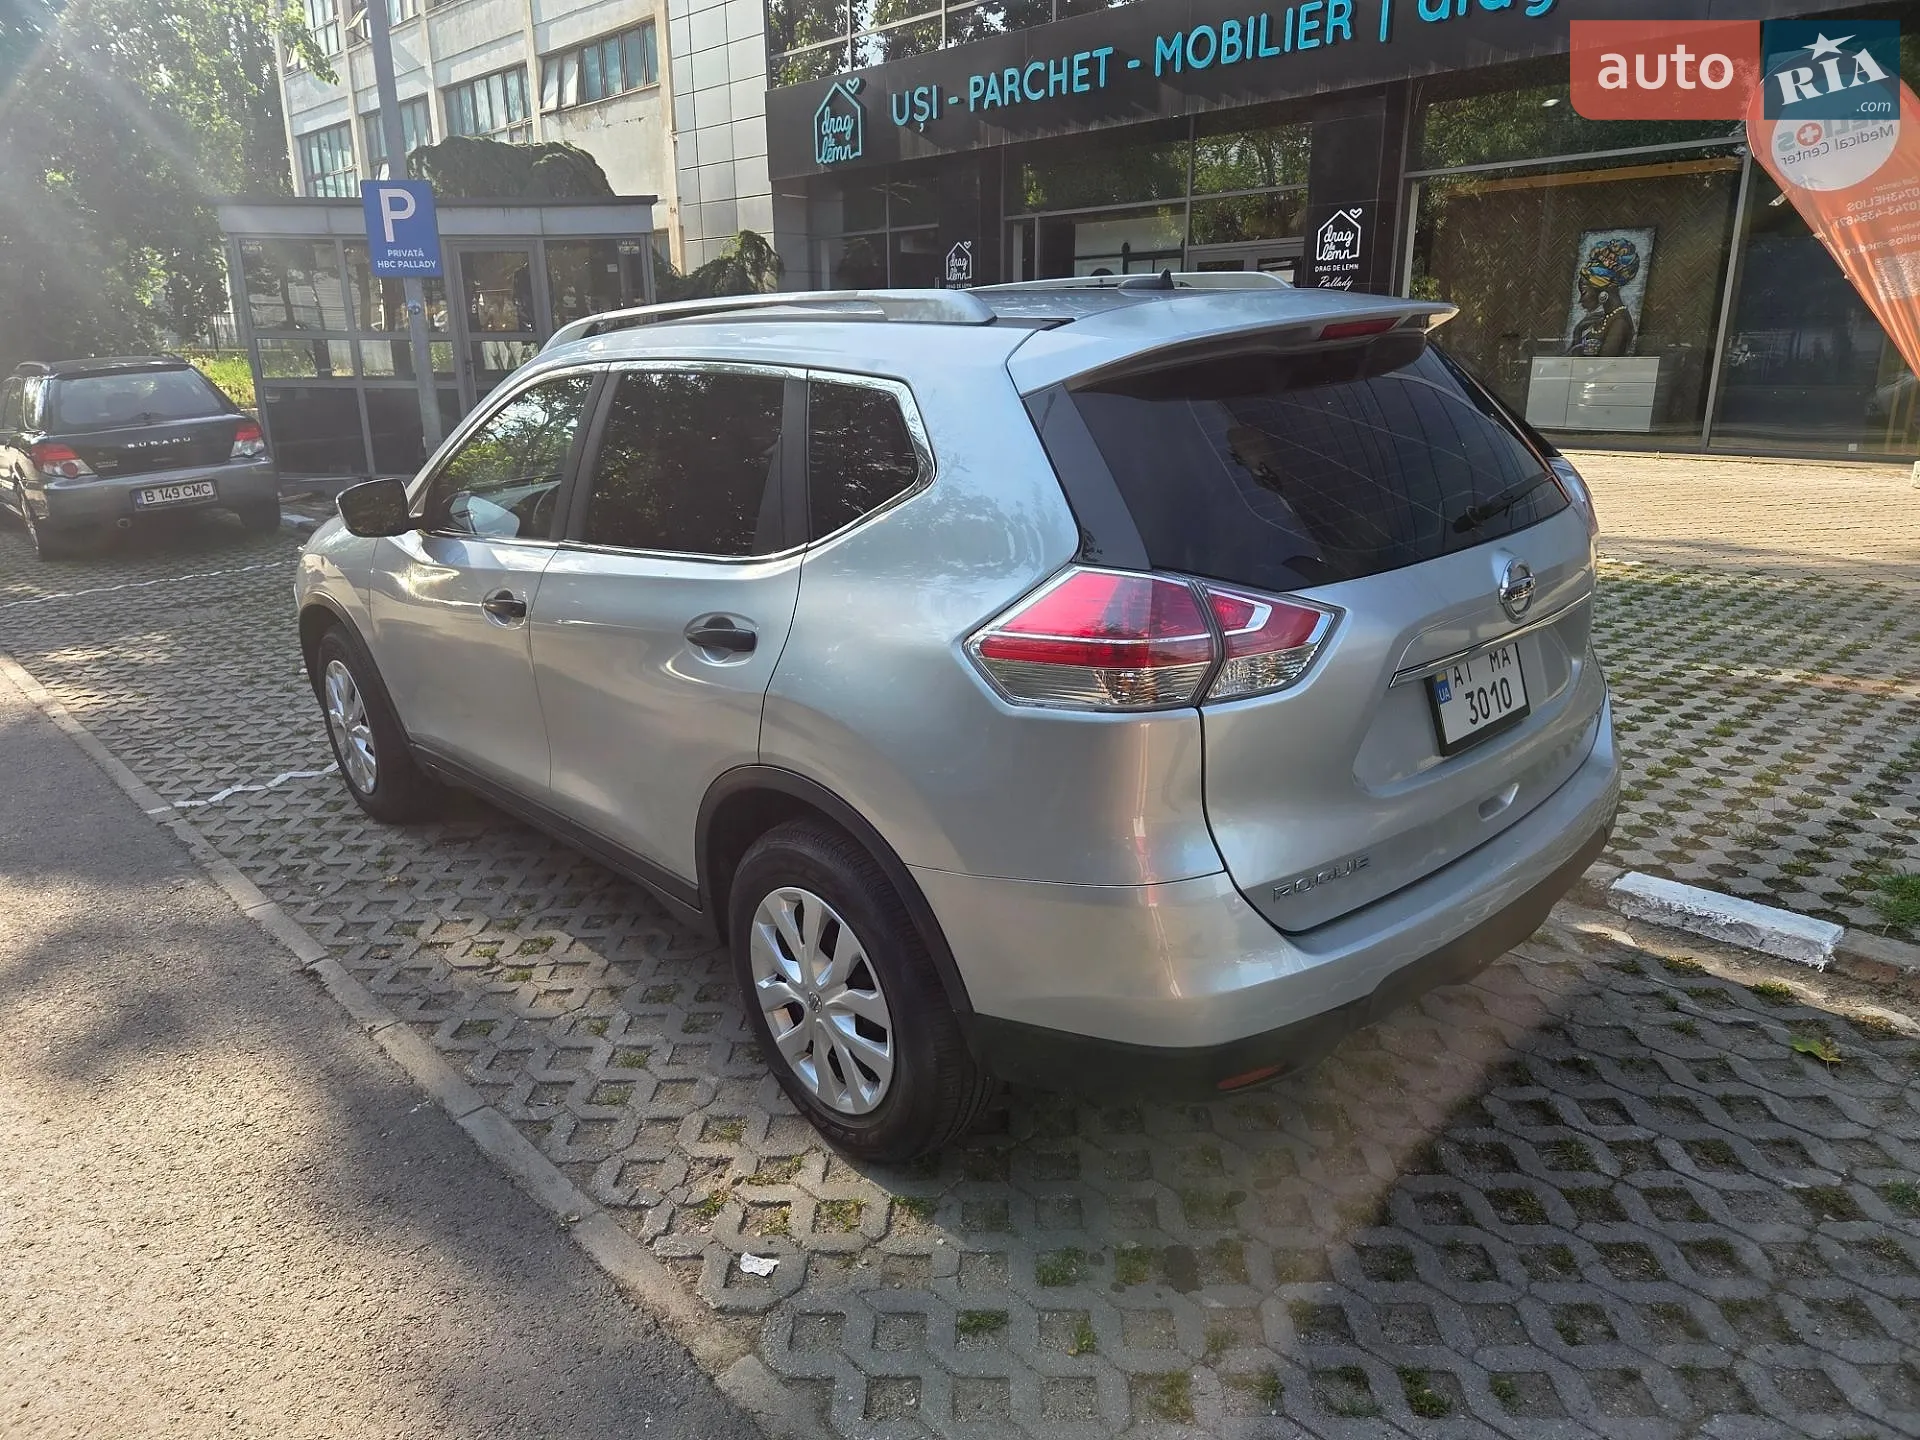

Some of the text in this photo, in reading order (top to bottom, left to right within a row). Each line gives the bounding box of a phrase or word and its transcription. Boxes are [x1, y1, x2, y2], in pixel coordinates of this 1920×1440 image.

[892, 84, 938, 133] UȘI
[968, 46, 1114, 112] PARCHET
[1154, 0, 1352, 77] MOBILIER
[821, 106, 854, 141] drag
[820, 136, 854, 163] lemn
[379, 188, 416, 242] P
[1323, 224, 1355, 247] drag
[1321, 243, 1351, 260] lemn
[377, 260, 437, 269] HBC PALLADY
[1342, 263, 1359, 271] LEMN
[145, 491, 155, 502] B
[159, 487, 180, 501] 149
[183, 483, 211, 497] CMC
[1489, 648, 1511, 672] MA
[1438, 687, 1450, 702] UA
[1465, 677, 1512, 725] 3010
